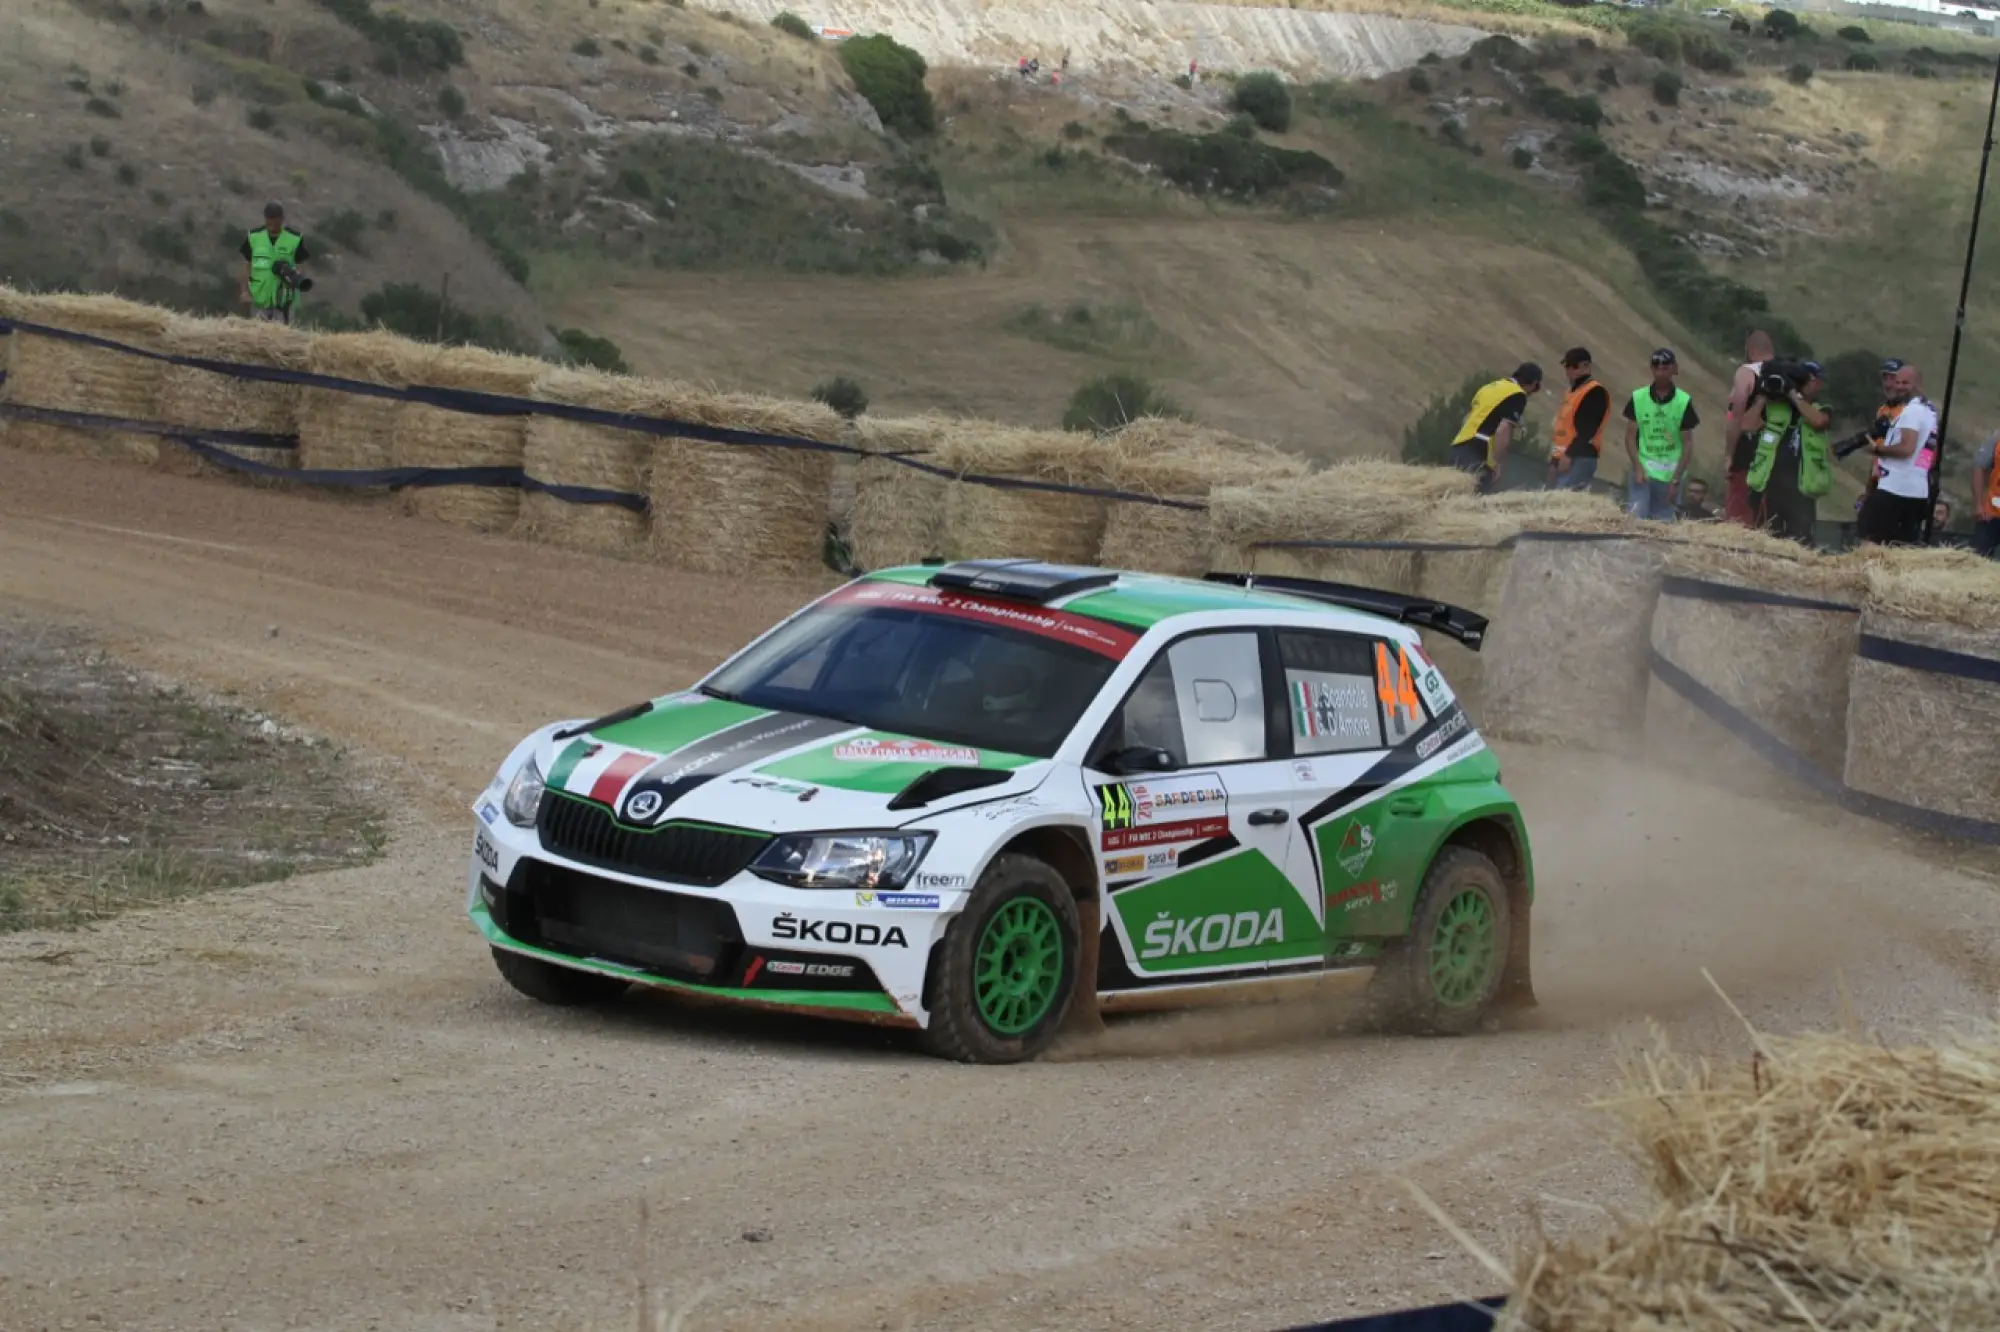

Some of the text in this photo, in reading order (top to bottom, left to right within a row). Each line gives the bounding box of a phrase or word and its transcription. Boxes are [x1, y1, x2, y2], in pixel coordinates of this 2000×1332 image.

[948, 597, 957, 608] 2
[960, 600, 1056, 628] Championship
[1377, 640, 1418, 721] 44
[1320, 682, 1369, 709] Scandola
[1326, 711, 1371, 737] D'Amore
[1102, 784, 1130, 829] 44
[1154, 788, 1224, 807] SARDEGNA
[1158, 827, 1194, 840] Championship
[1148, 852, 1166, 863] sara
[916, 871, 965, 888] freem
[771, 911, 909, 949] ŠKODA
[1140, 908, 1284, 960] ŠKODA
[806, 964, 855, 977] EDGE
